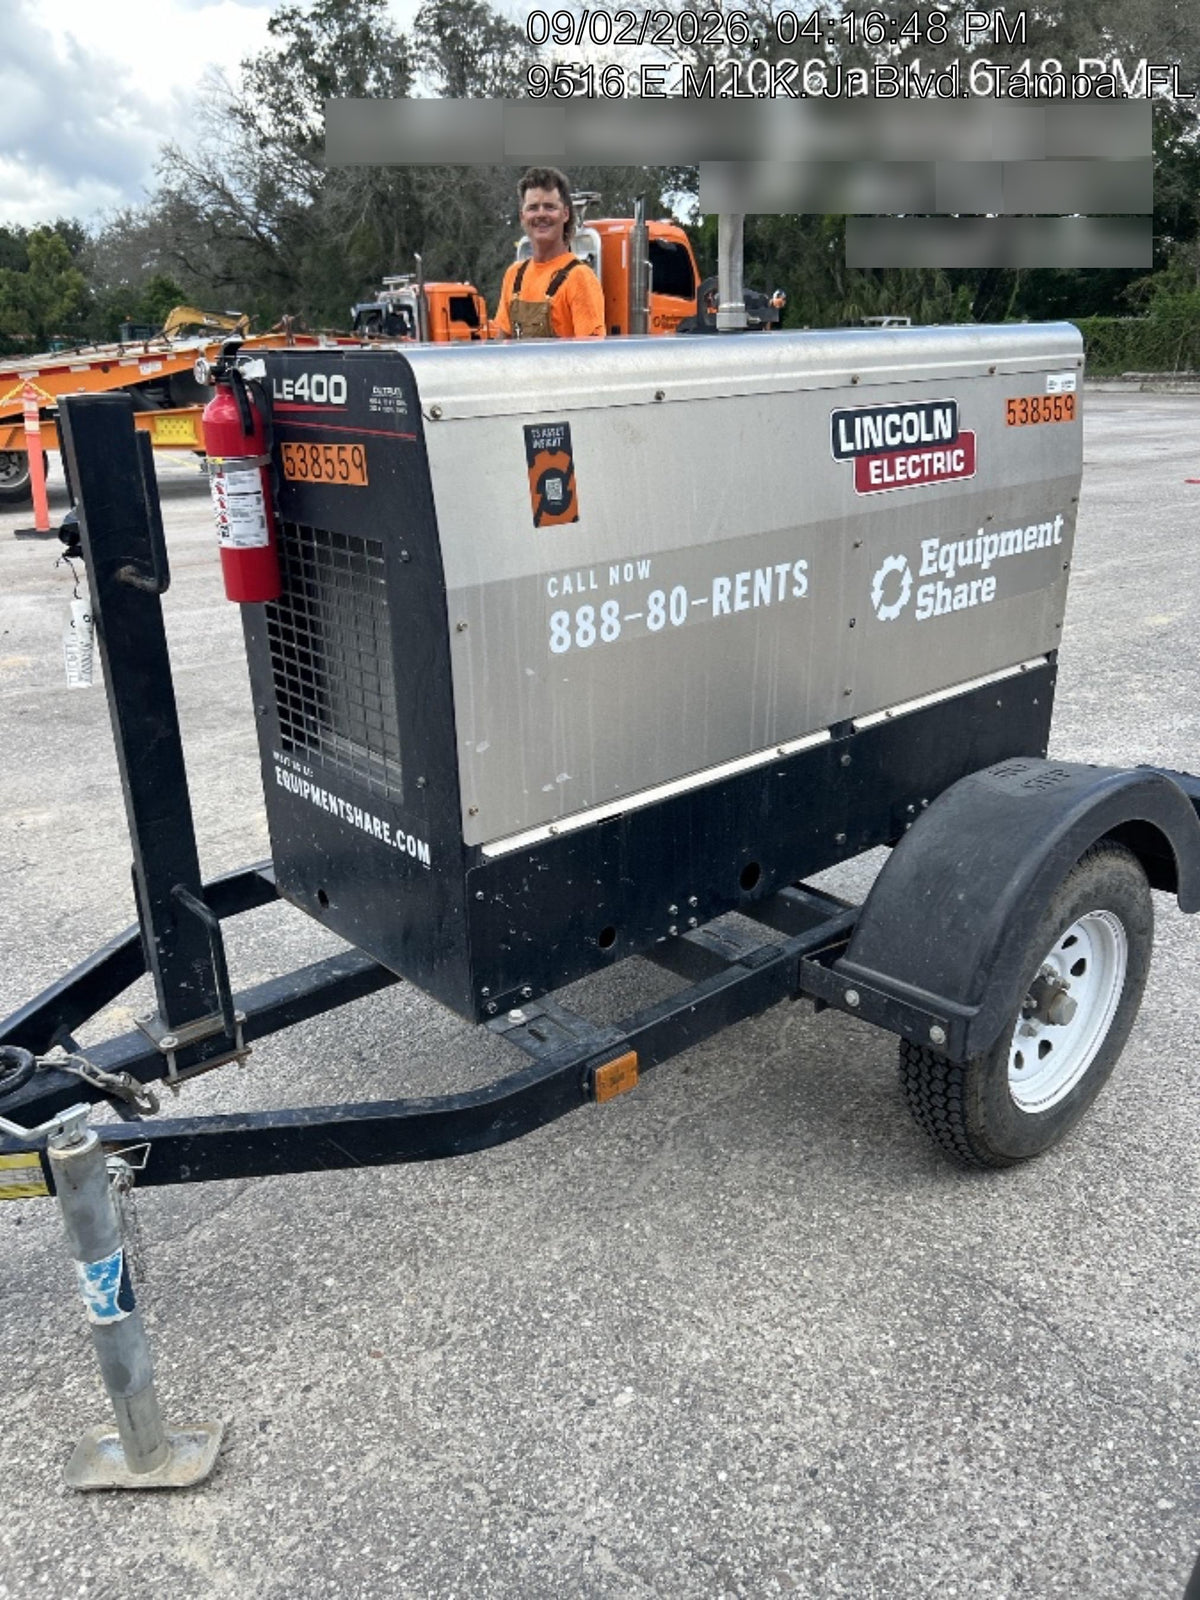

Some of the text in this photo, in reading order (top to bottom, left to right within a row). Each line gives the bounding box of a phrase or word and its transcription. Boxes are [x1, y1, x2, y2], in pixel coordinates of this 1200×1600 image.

[273, 373, 347, 404] LE400
[838, 408, 953, 453] LINCOLN
[1007, 395, 1074, 425] 538559
[284, 444, 365, 482] 538559
[869, 448, 965, 485] ELECTRIC
[919, 512, 1064, 578] Equipment
[547, 559, 651, 598] CALL NOW
[915, 575, 997, 622] Share
[549, 559, 808, 654] 888-80-RENTS
[275, 765, 431, 866] EQUIPMENTSHARE.COM
